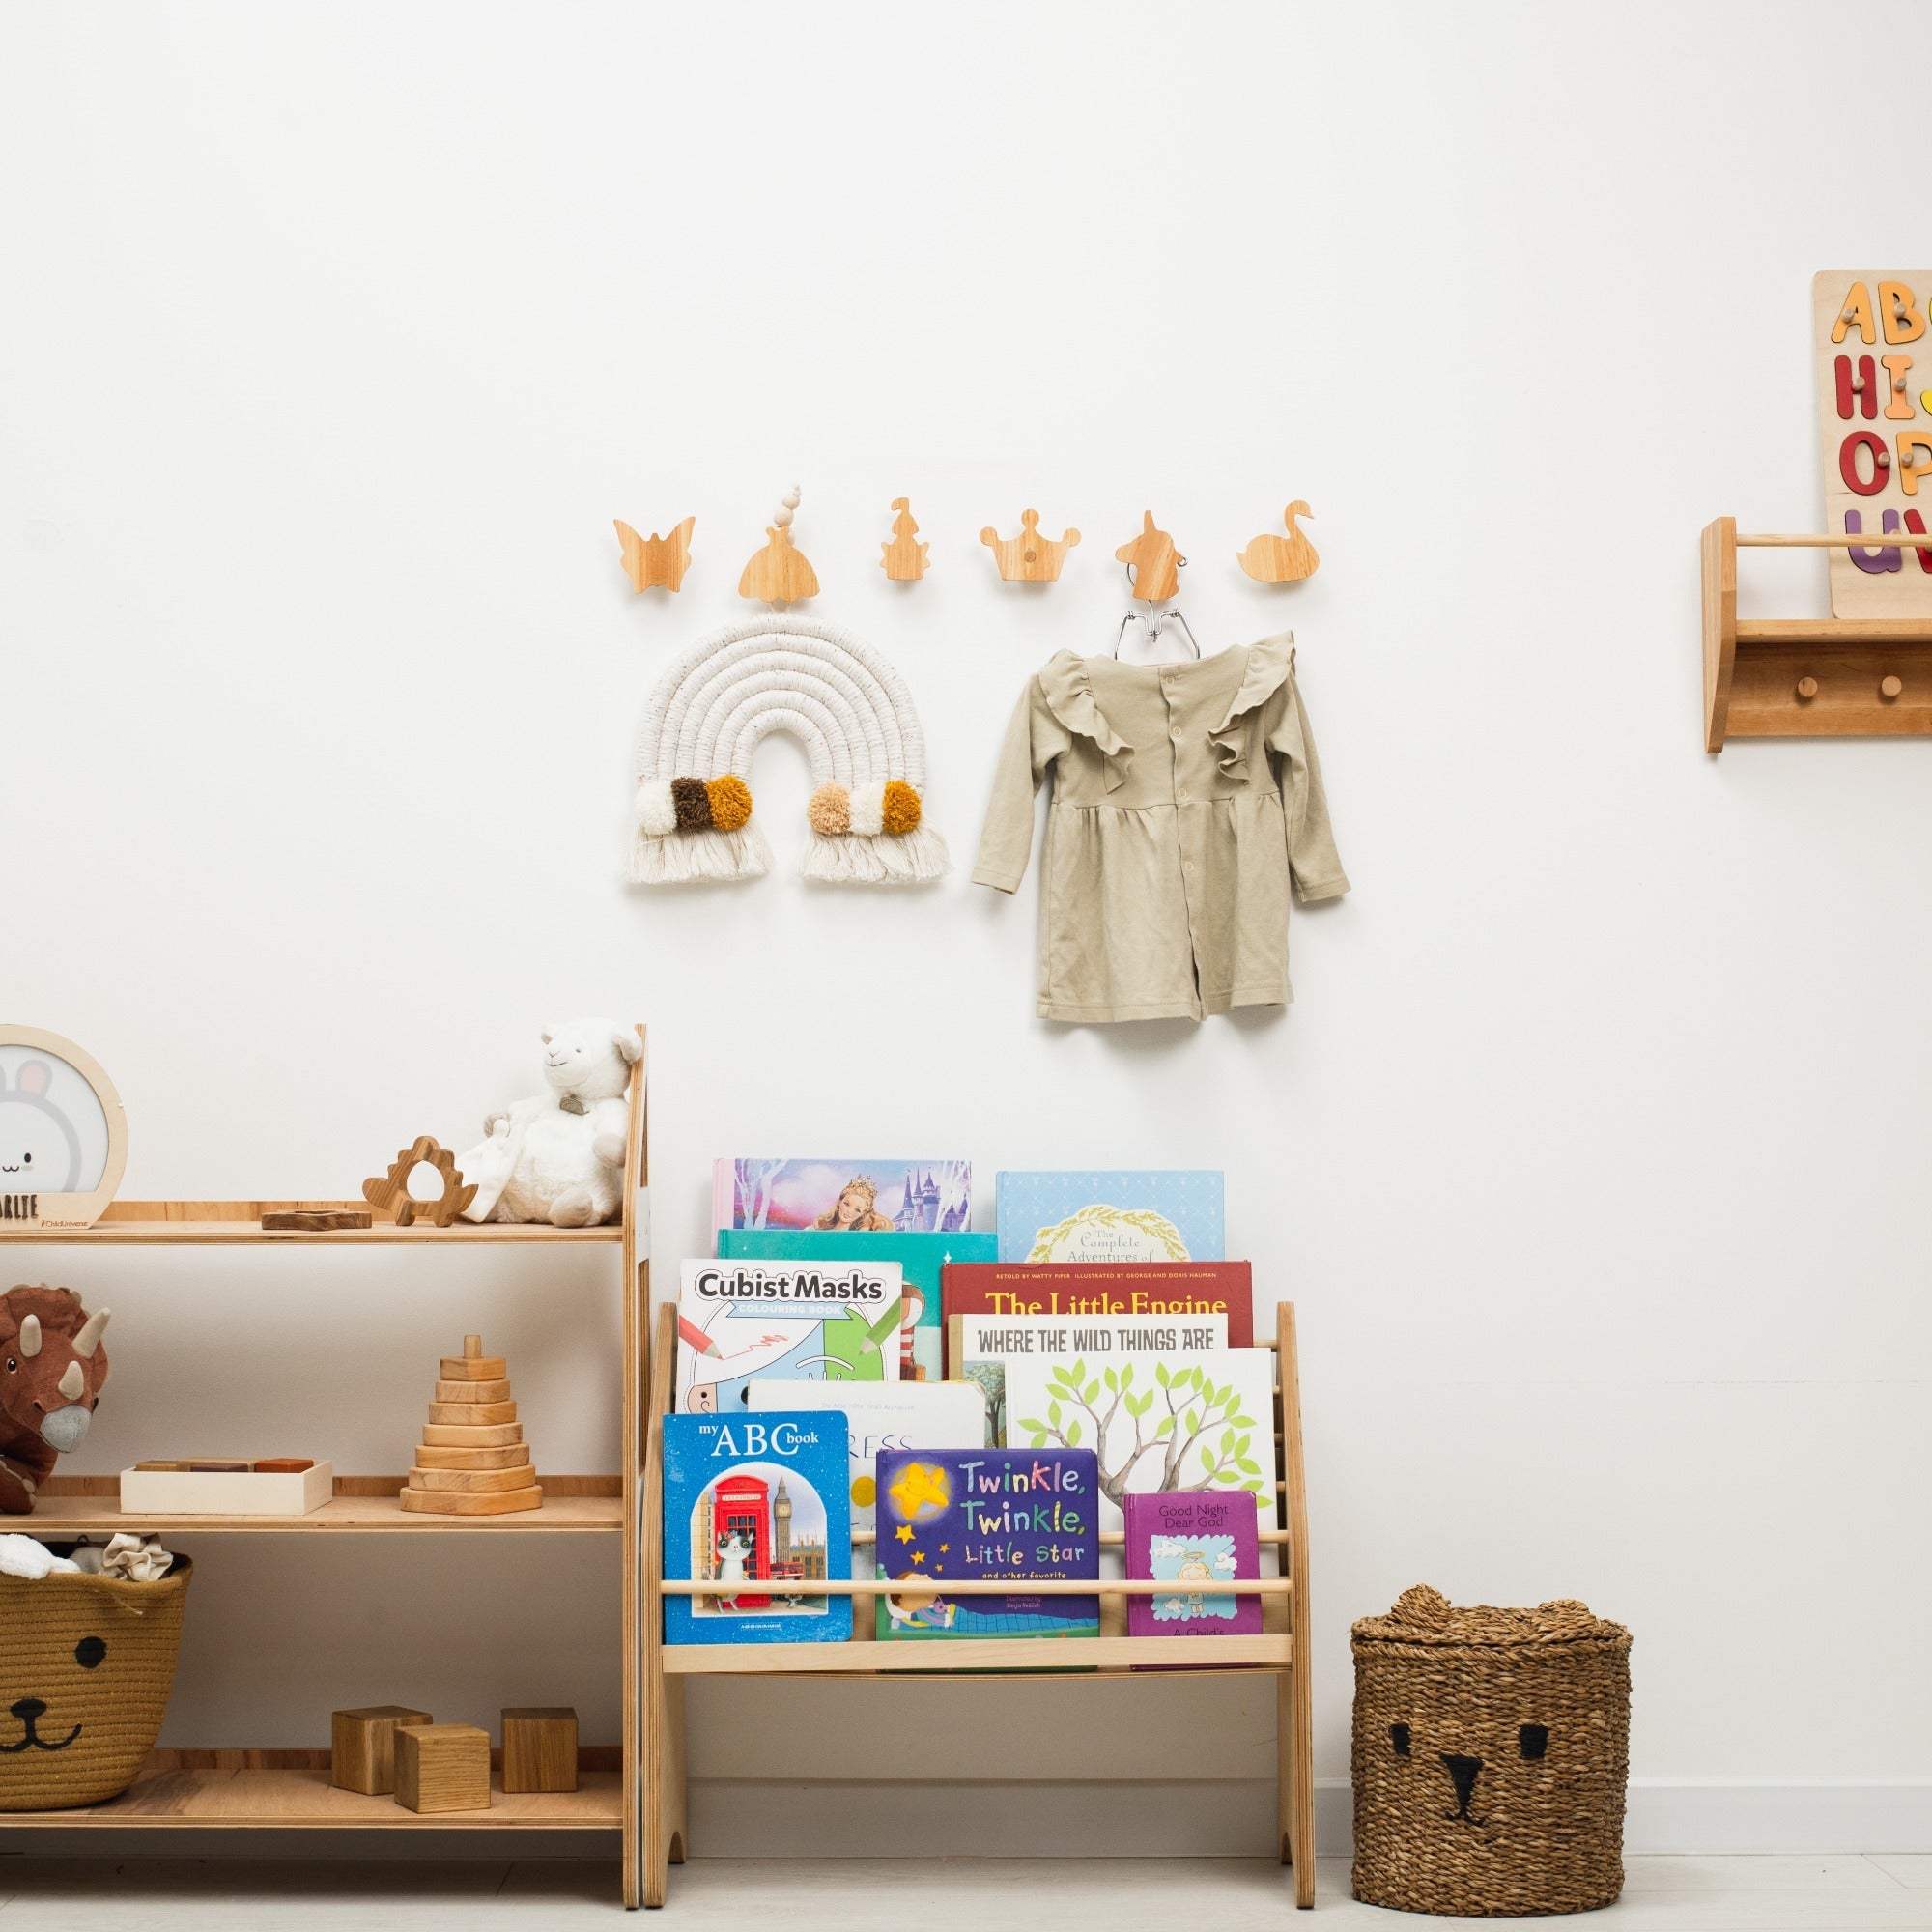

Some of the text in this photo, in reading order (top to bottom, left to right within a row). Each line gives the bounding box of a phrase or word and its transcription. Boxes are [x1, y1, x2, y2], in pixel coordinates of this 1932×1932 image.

[0, 1194, 39, 1219] RLIE
[1080, 1232, 1140, 1253] Complete
[1094, 1229, 1114, 1238] The
[1067, 1249, 1154, 1263] Adventures of
[698, 1273, 882, 1299] Cubist Masks
[738, 1304, 842, 1315] COLOURING BOOK
[985, 1292, 1227, 1314] The Little Engine
[978, 1328, 1214, 1353] WHERE THE WILD THINGS ARE
[698, 1423, 819, 1456] my ABC book
[958, 1460, 1085, 1494] Twinkle,
[959, 1500, 1085, 1535] Twinkle,
[1159, 1504, 1229, 1518] Good Night
[1165, 1516, 1223, 1528] Dear God
[965, 1541, 1024, 1565] Little
[982, 1571, 1066, 1579] and other favorite
[1187, 1627, 1225, 1636] Child's
